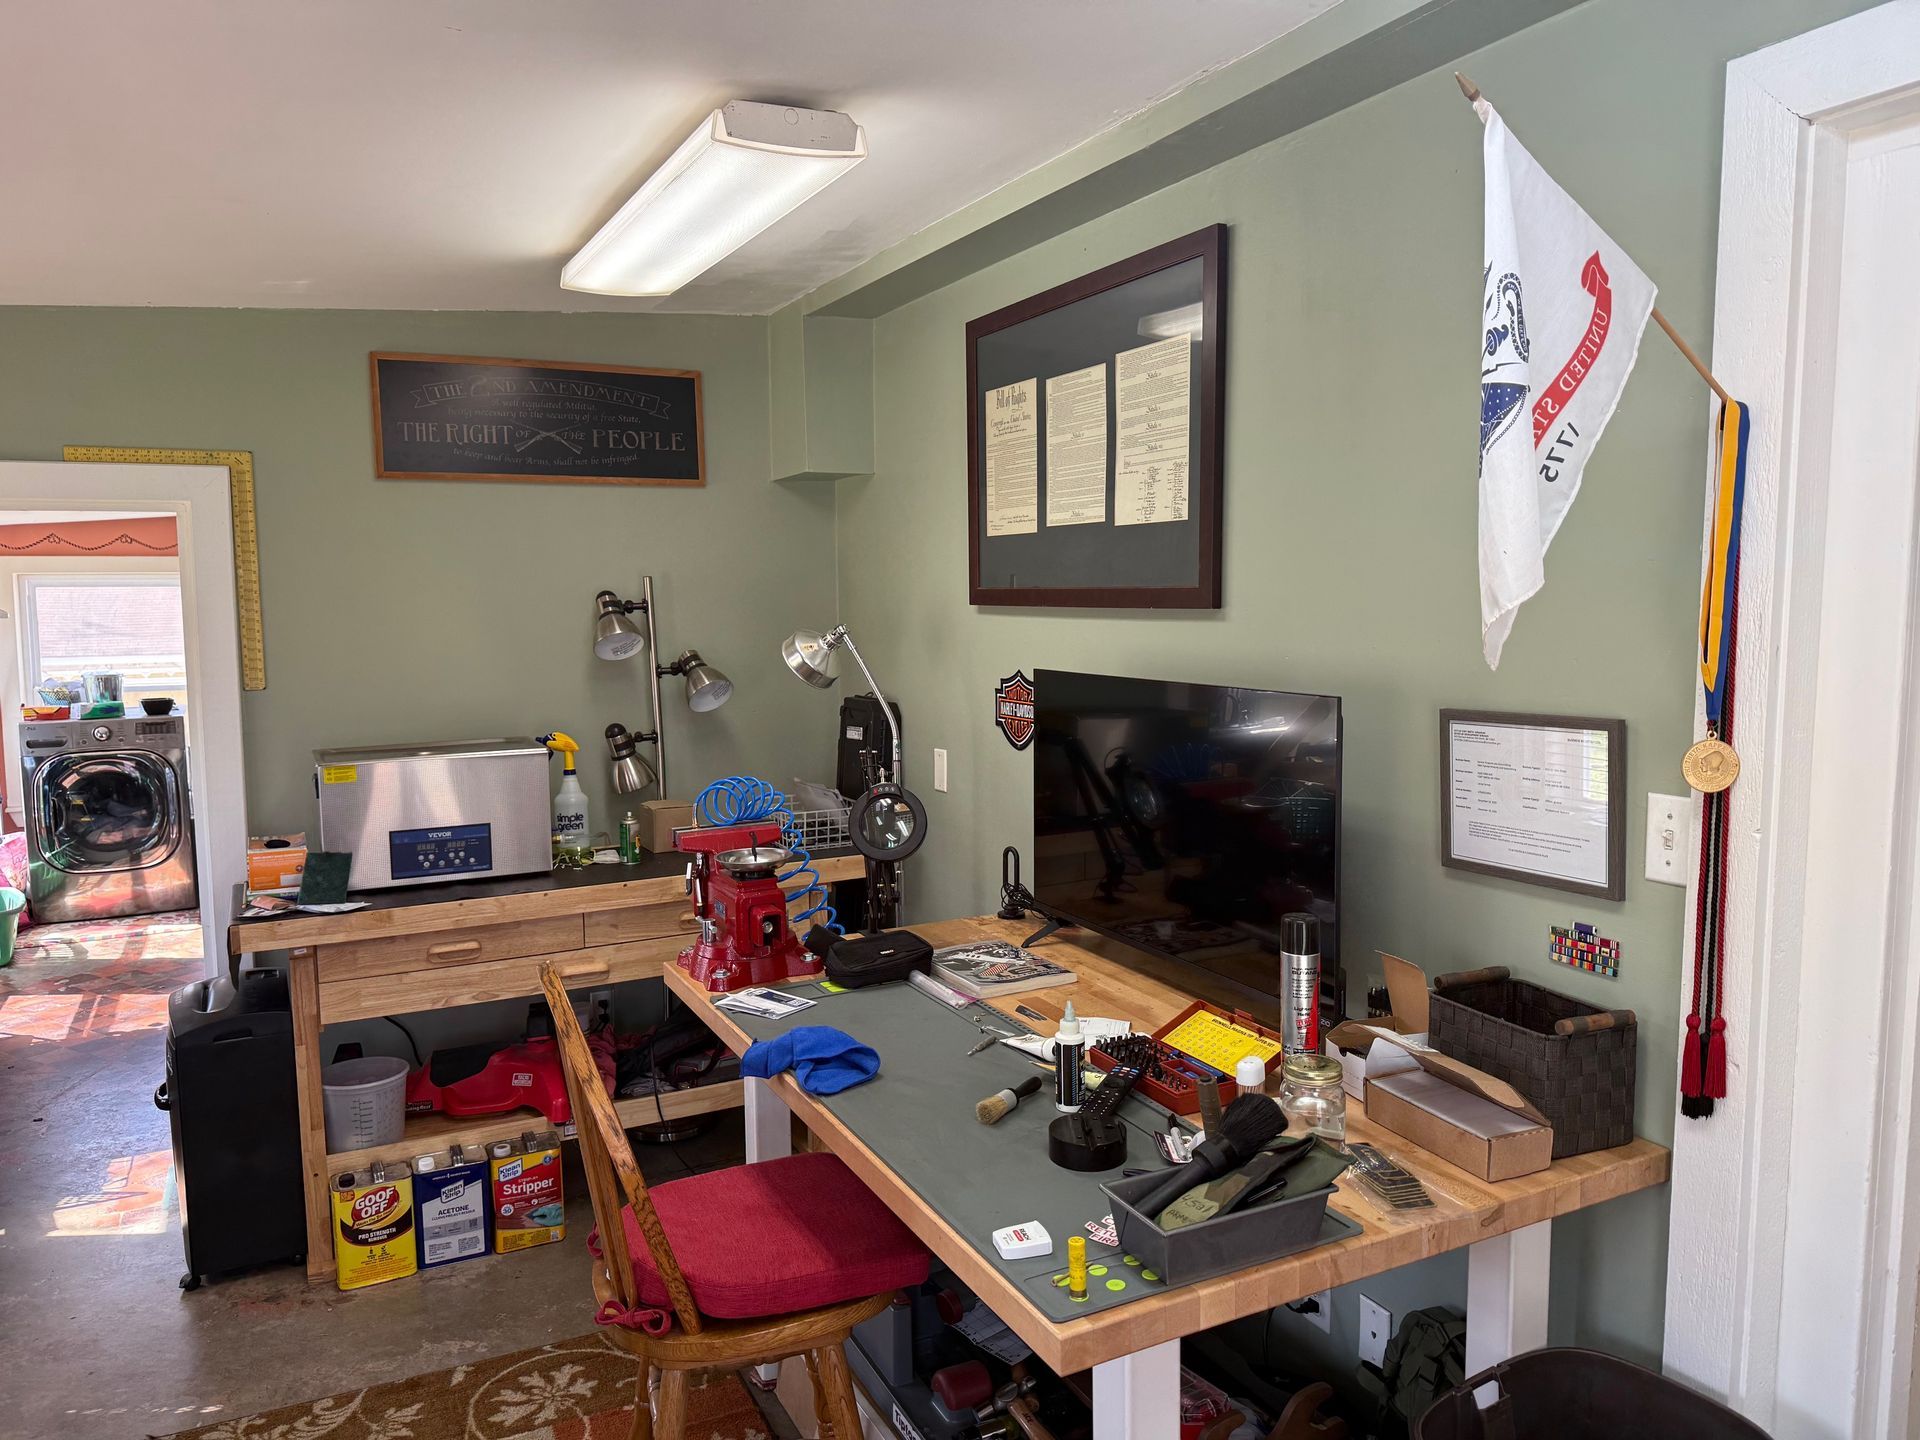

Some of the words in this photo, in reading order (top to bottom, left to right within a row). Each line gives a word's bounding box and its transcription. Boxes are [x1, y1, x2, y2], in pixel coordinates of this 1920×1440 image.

[429, 382, 463, 398] THE
[525, 380, 651, 408] AMENDMENT
[519, 409, 529, 418] to
[530, 409, 544, 419] the
[397, 422, 440, 443] THE
[445, 423, 514, 446] RIGHT
[515, 430, 531, 438] OF
[592, 428, 686, 451] PEOPLE
[1000, 701, 1035, 719] HARLEY-DAVIDSO
[556, 812, 584, 824] simple
[557, 821, 584, 833] green
[500, 1163, 521, 1175] Klean
[502, 1170, 519, 1180] Strip
[442, 1183, 463, 1196] Klean
[503, 1177, 554, 1196] Stripper
[355, 1186, 395, 1210] GOOF
[444, 1189, 461, 1200] Strip
[361, 1199, 389, 1219] OFF
[438, 1204, 470, 1216] ACETONE
[358, 1232, 370, 1241] PRO
[370, 1227, 397, 1238] STRENGTH
[1087, 1222, 1118, 1238] RETU
[1091, 1233, 1119, 1247] FIRE
